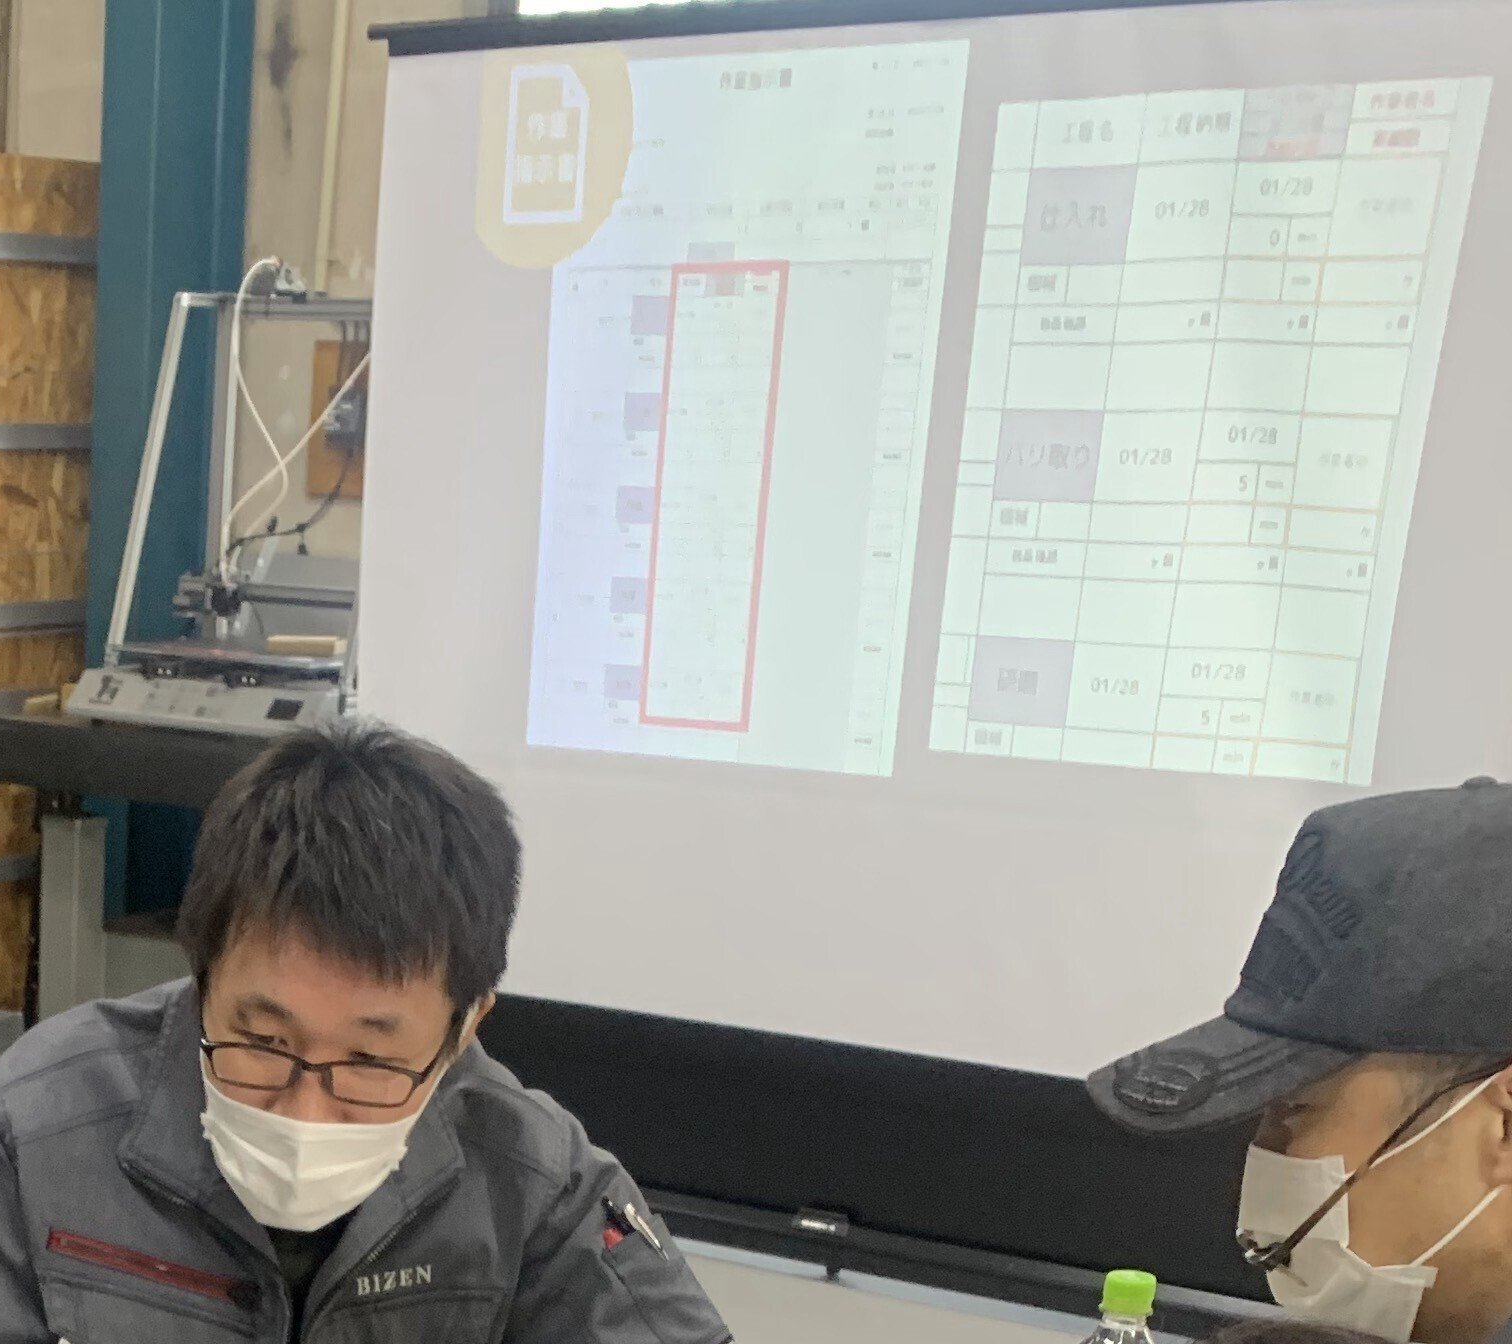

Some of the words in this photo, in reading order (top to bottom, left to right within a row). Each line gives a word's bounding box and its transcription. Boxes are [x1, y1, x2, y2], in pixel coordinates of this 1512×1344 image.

[1228, 425, 1279, 447] 01/28
[1119, 447, 1173, 466] 01/28
[1191, 661, 1248, 682] 01/28
[356, 1264, 432, 1296] BIZEN
